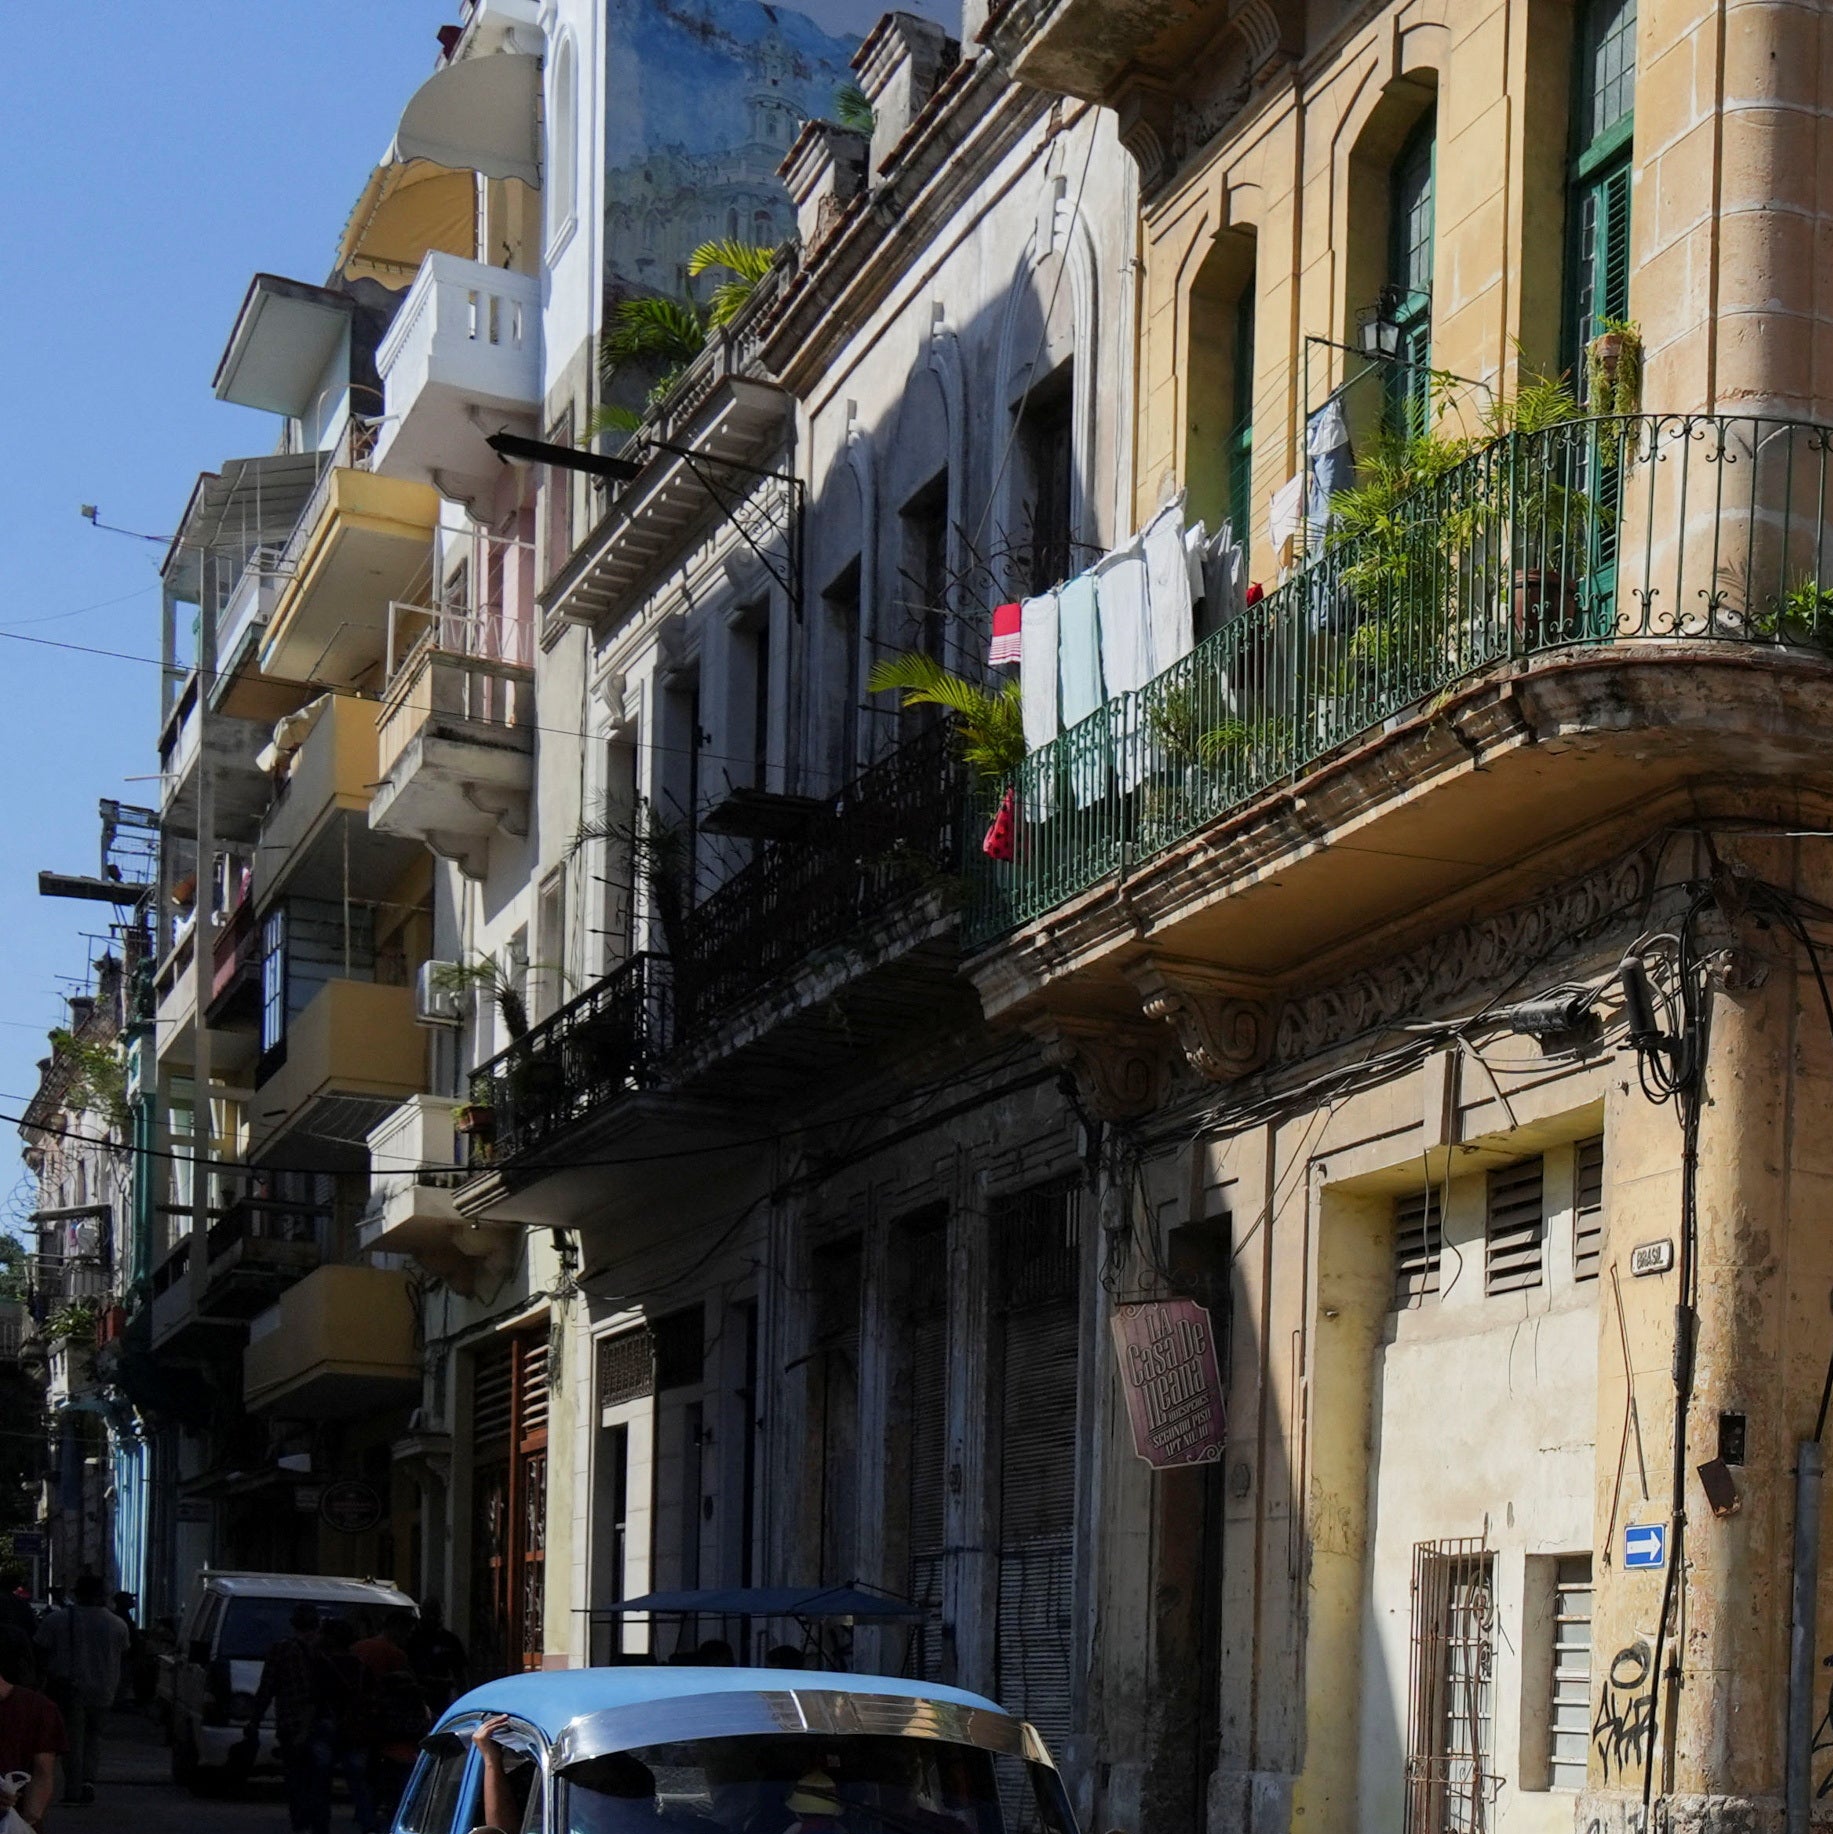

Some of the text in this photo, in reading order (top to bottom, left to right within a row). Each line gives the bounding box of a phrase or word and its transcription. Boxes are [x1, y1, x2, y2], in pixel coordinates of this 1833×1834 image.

[1636, 1246, 1663, 1270] BRASIL
[1146, 1307, 1175, 1344] LA
[1126, 1318, 1207, 1388] Casa De
[1152, 1417, 1192, 1449] SEGUNDO
